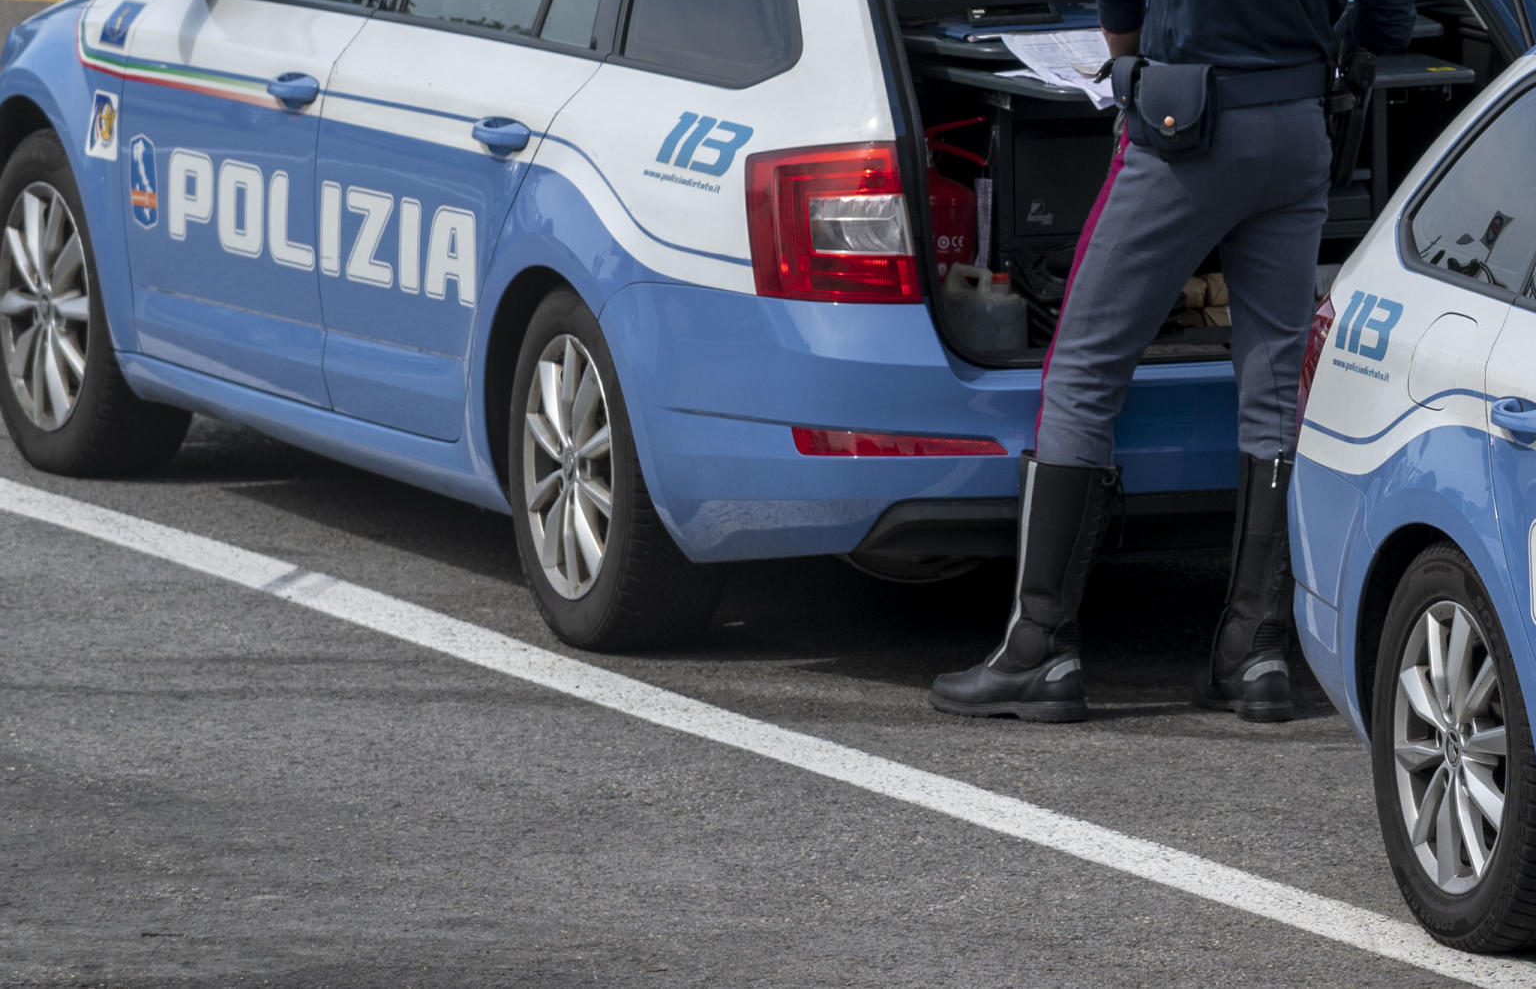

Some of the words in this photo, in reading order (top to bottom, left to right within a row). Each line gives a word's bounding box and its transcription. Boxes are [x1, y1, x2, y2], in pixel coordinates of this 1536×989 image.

[655, 111, 754, 177] 113
[168, 147, 477, 308] POLIZIA
[1335, 290, 1404, 361] 113
